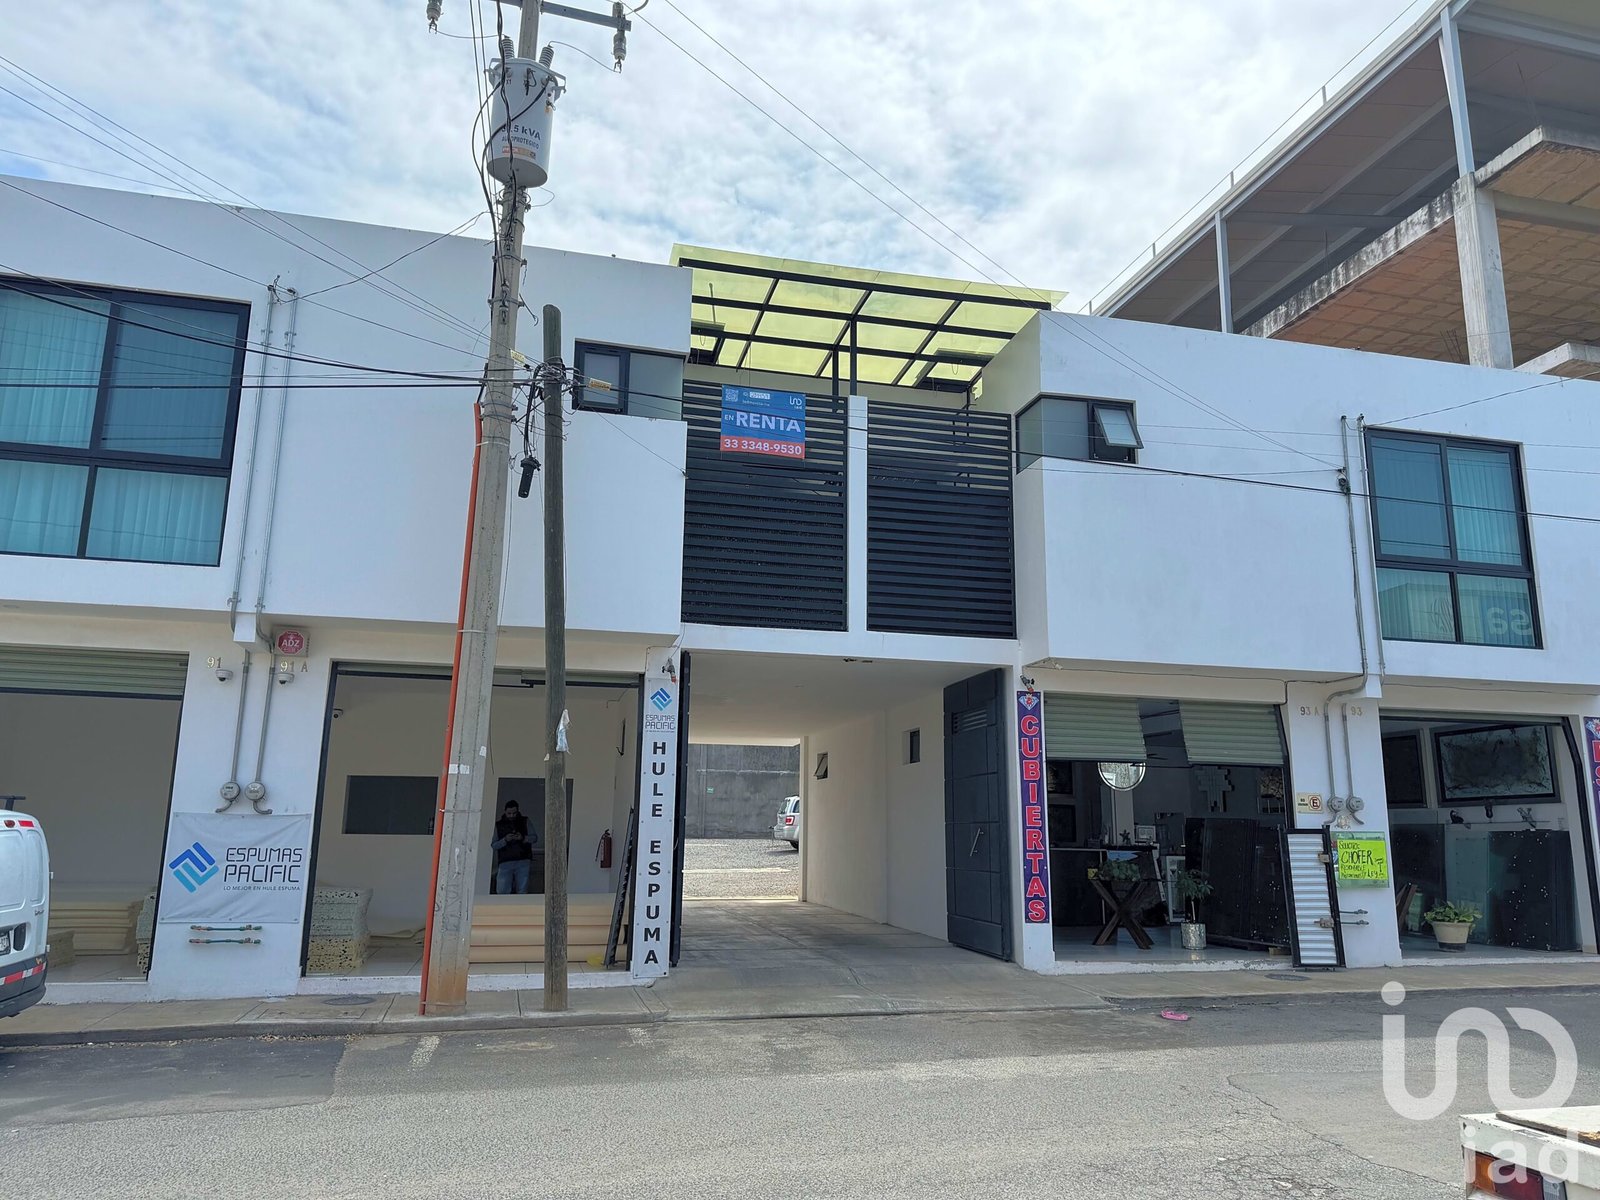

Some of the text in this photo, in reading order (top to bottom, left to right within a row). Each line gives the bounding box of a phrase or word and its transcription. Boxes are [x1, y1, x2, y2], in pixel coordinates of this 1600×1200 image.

[521, 126, 541, 141] kVA
[736, 411, 801, 433] RENTA
[724, 438, 802, 455] 33 3348-9530
[281, 639, 300, 648] ADZ
[207, 656, 222, 669] 91
[280, 660, 308, 673] 91 A
[645, 714, 676, 722] ESPUMAS
[1300, 706, 1320, 716] 93 A
[1350, 706, 1363, 717] 93
[645, 721, 676, 730] PACIFIC
[651, 741, 667, 818] HULE
[1020, 715, 1047, 922] CUBIERTAS
[225, 847, 303, 863] ESPUMAS
[1341, 849, 1374, 866] CHOFER
[223, 864, 301, 883] PACIFIC
[643, 840, 662, 965] ESPUMA
